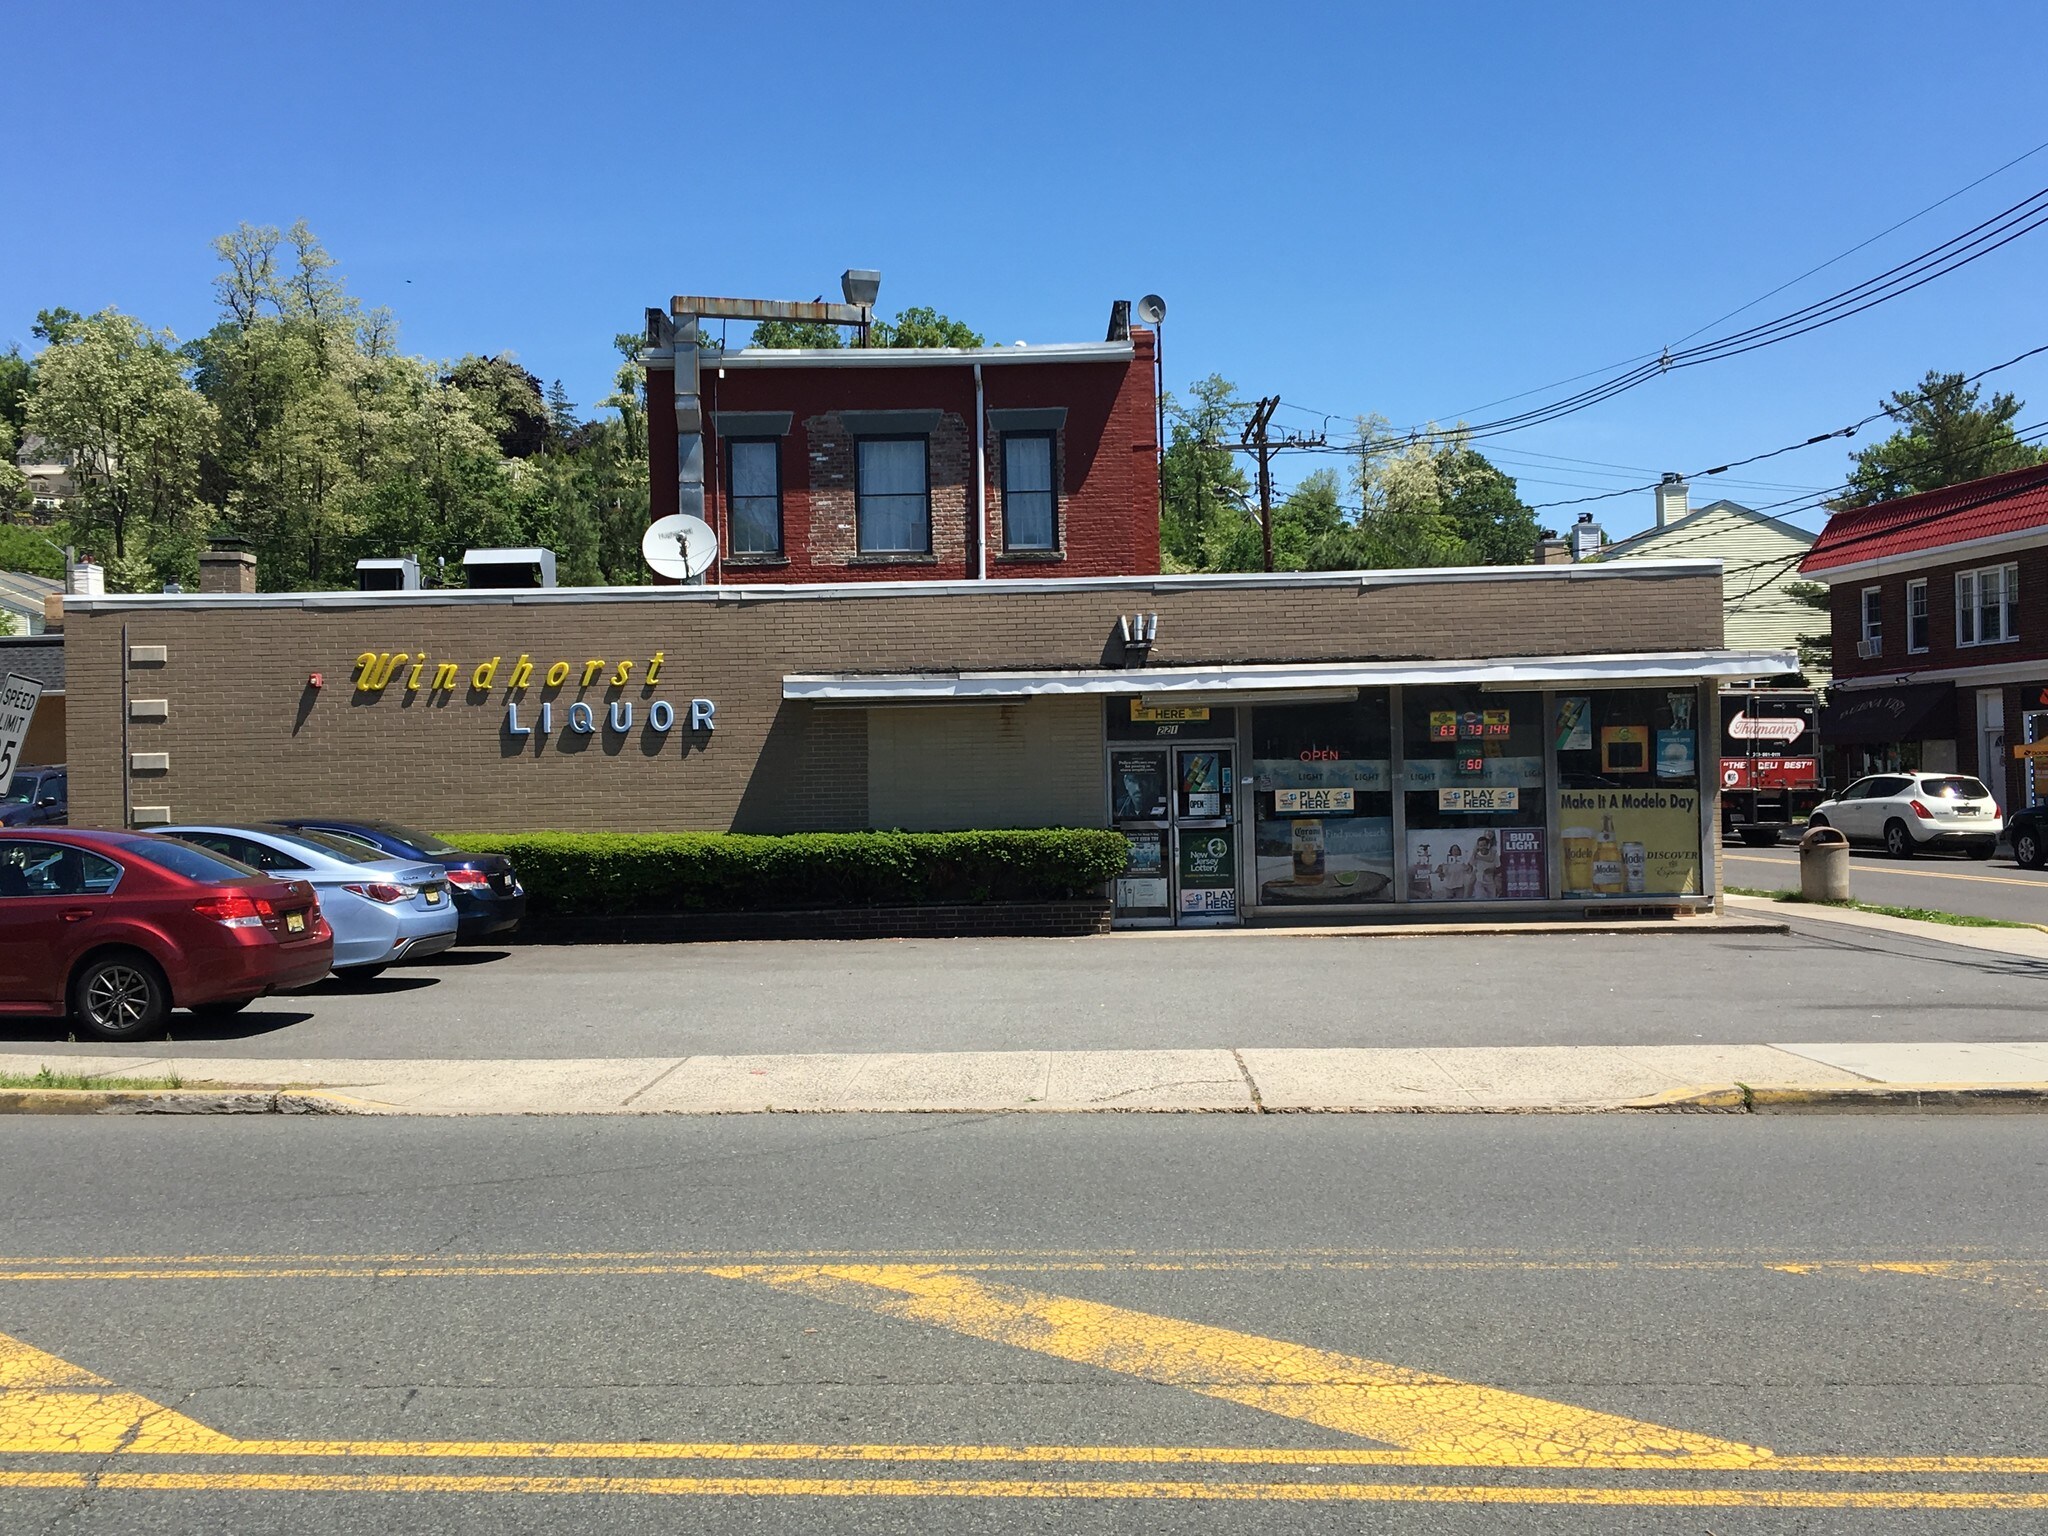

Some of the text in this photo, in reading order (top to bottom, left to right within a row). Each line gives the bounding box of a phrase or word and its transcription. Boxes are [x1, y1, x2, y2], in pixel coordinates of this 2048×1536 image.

[356, 652, 664, 692] Windhorst
[2, 687, 36, 711] SPEED
[509, 698, 716, 734] LIQUOR
[1155, 709, 1186, 719] HERE
[1156, 724, 1179, 736] 221
[1440, 724, 1457, 736] 63
[1468, 724, 1483, 736] 73
[1487, 723, 1510, 735] 144
[1299, 750, 1339, 762] OPEN
[1466, 758, 1483, 770] 50
[1757, 761, 1778, 769] DELI
[1298, 773, 1324, 781] LIGHT
[1354, 773, 1380, 781] LIGHT
[1299, 790, 1330, 800] PLAY
[1463, 790, 1495, 799] PLAY
[1189, 800, 1204, 809] OPEN
[1299, 800, 1331, 809] HERE
[1463, 799, 1495, 808] HERE
[1561, 792, 1694, 813] Make It A Modelo Day
[1294, 827, 1320, 838] Corona
[1509, 832, 1534, 842] BUD
[1505, 841, 1540, 851] LIGHT
[1190, 851, 1208, 859] New
[1646, 851, 1698, 860] DISCOVER
[1194, 858, 1218, 867] Jersey
[1190, 864, 1218, 873] Lottery
[1204, 890, 1235, 900] PLAY
[1205, 900, 1235, 909] HERE
